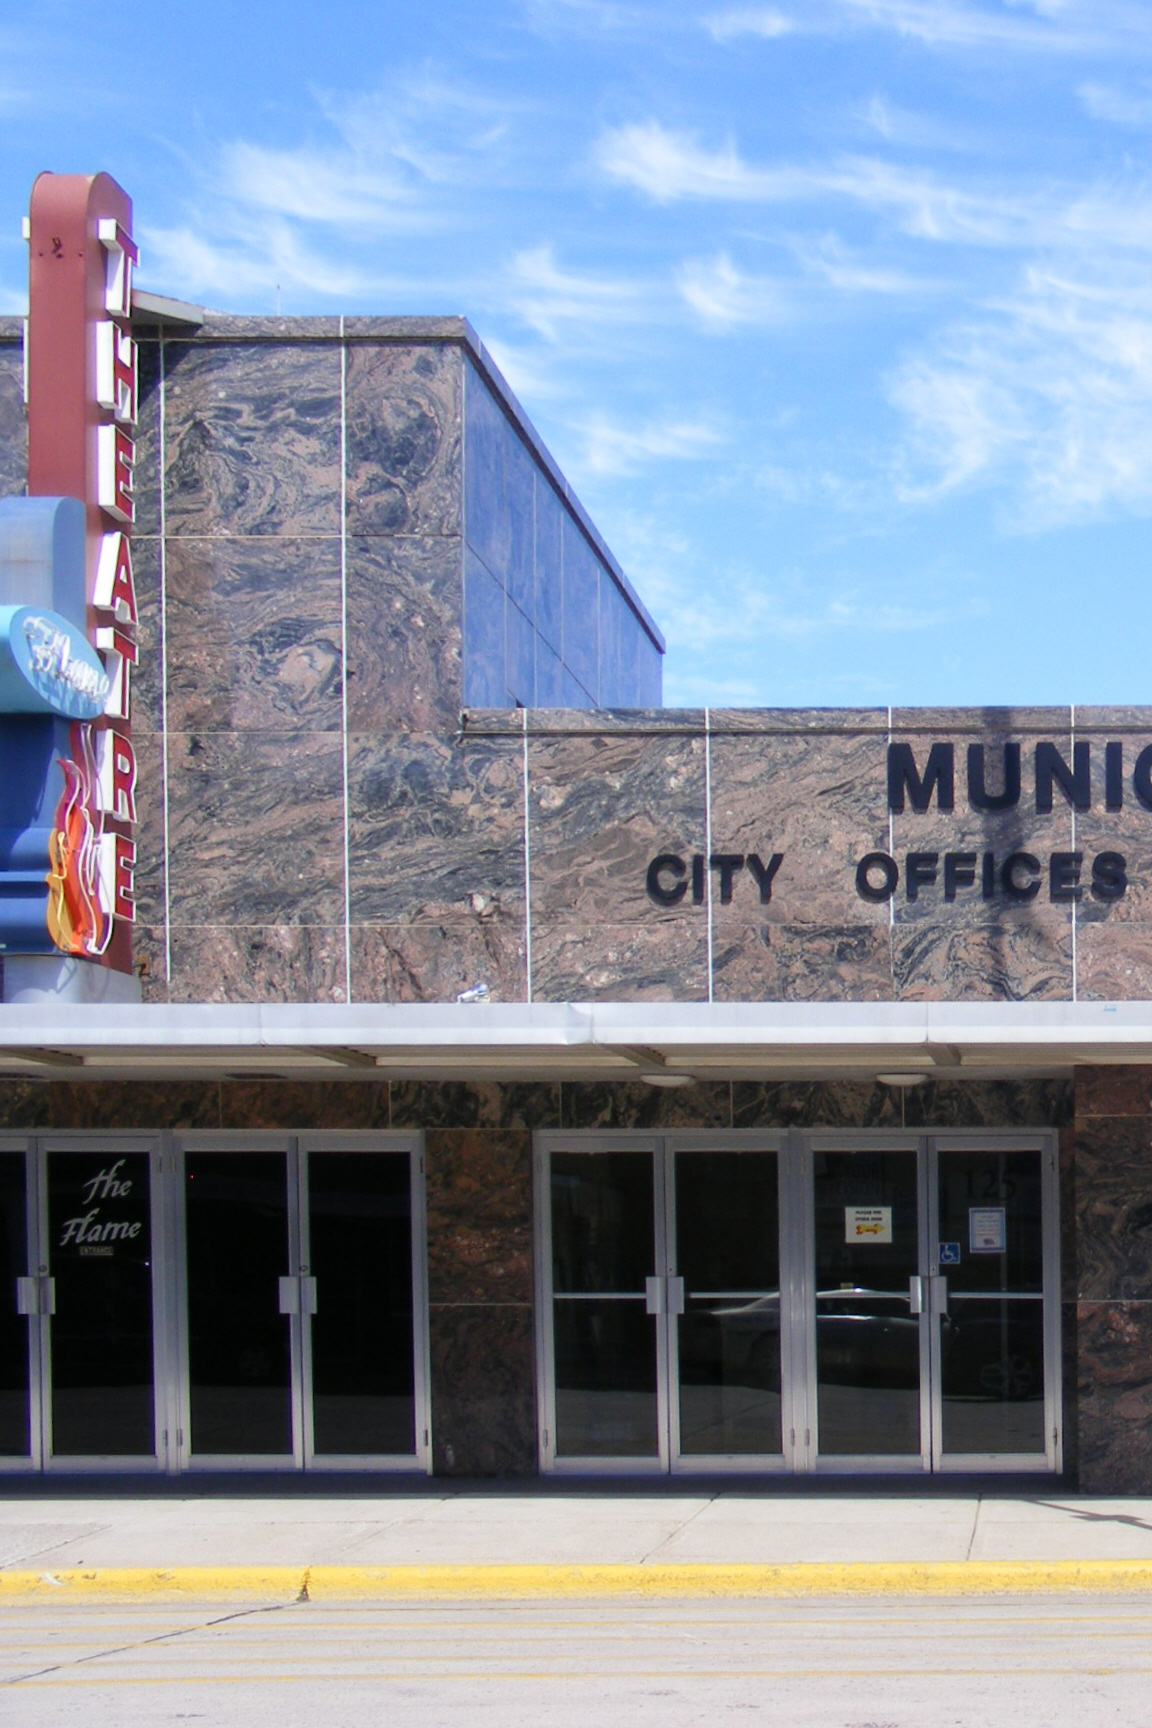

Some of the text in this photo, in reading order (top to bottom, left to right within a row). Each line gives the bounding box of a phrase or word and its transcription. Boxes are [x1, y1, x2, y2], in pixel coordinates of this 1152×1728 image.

[96, 217, 140, 923] THEATRE
[646, 850, 1128, 907] CITY OFFICES
[964, 1167, 1018, 1201] 125
[59, 1207, 142, 1247] Flame
